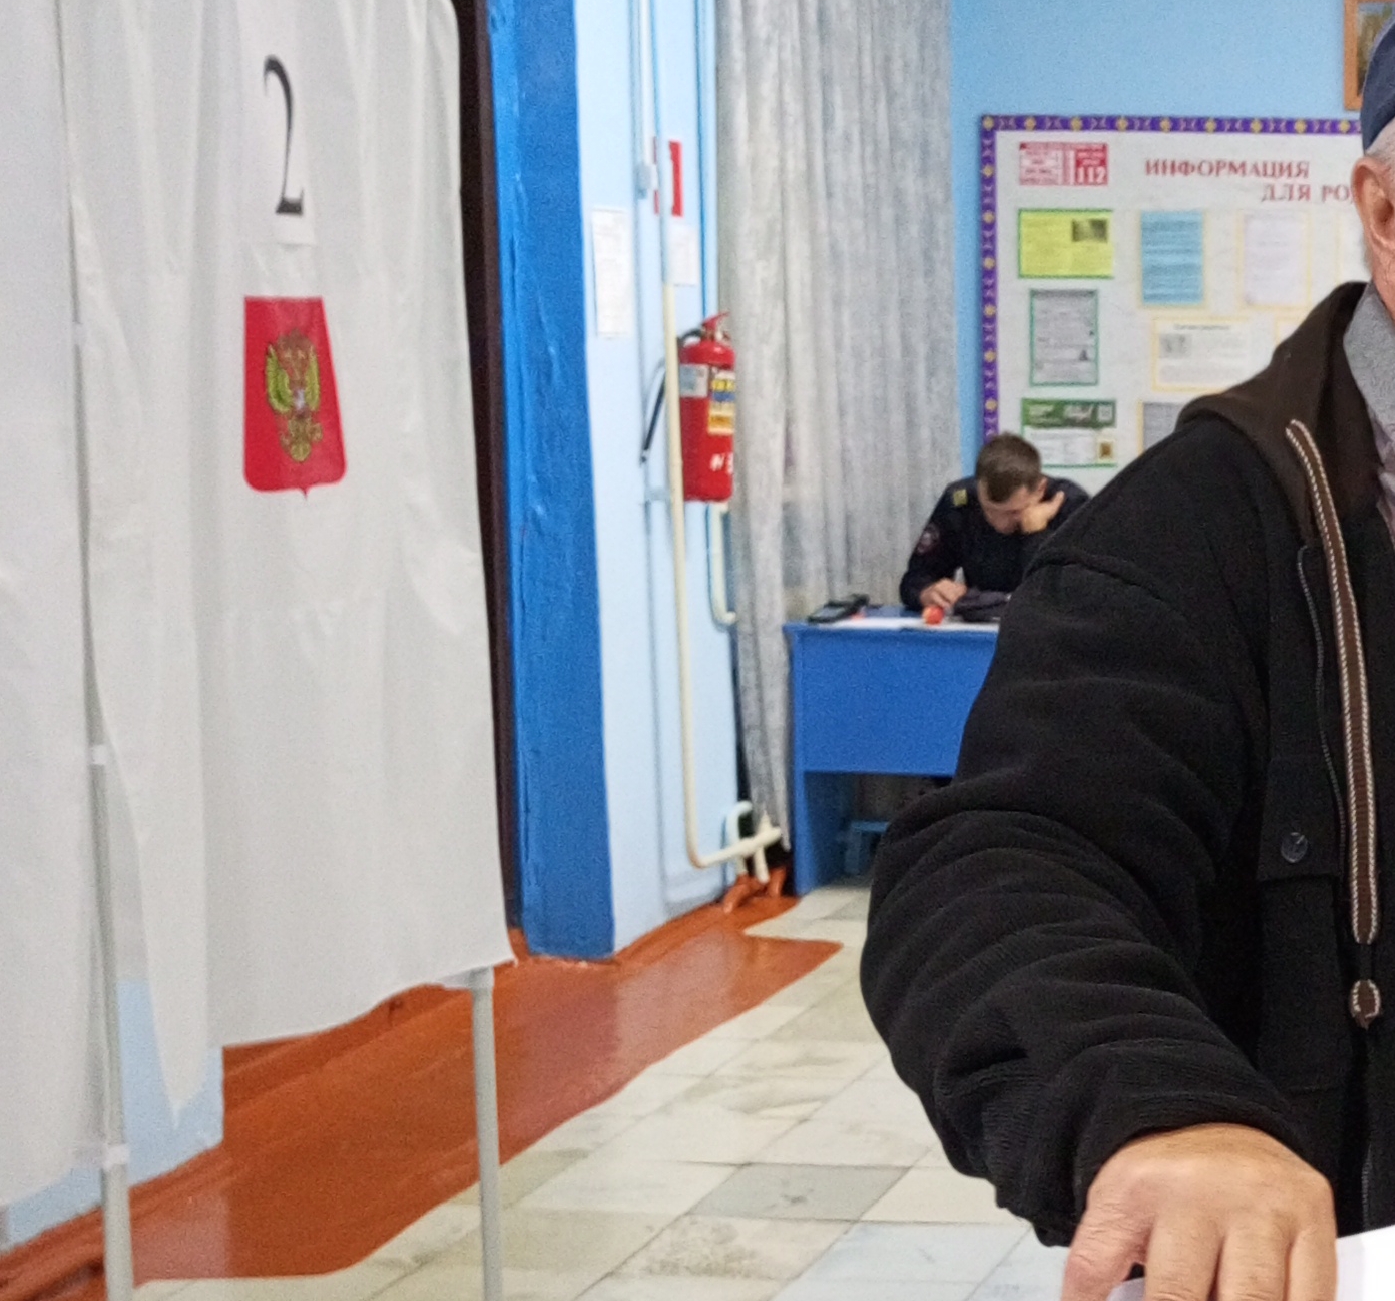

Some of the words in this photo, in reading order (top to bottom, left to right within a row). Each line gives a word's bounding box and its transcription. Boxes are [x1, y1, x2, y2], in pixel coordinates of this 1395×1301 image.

[264, 54, 304, 215] 2
[1077, 166, 1106, 184] 112
[1144, 158, 1310, 179] ИНФОРМАЦИЯ
[1261, 183, 1312, 203] ДЛЯ
[1321, 183, 1355, 204] РО
